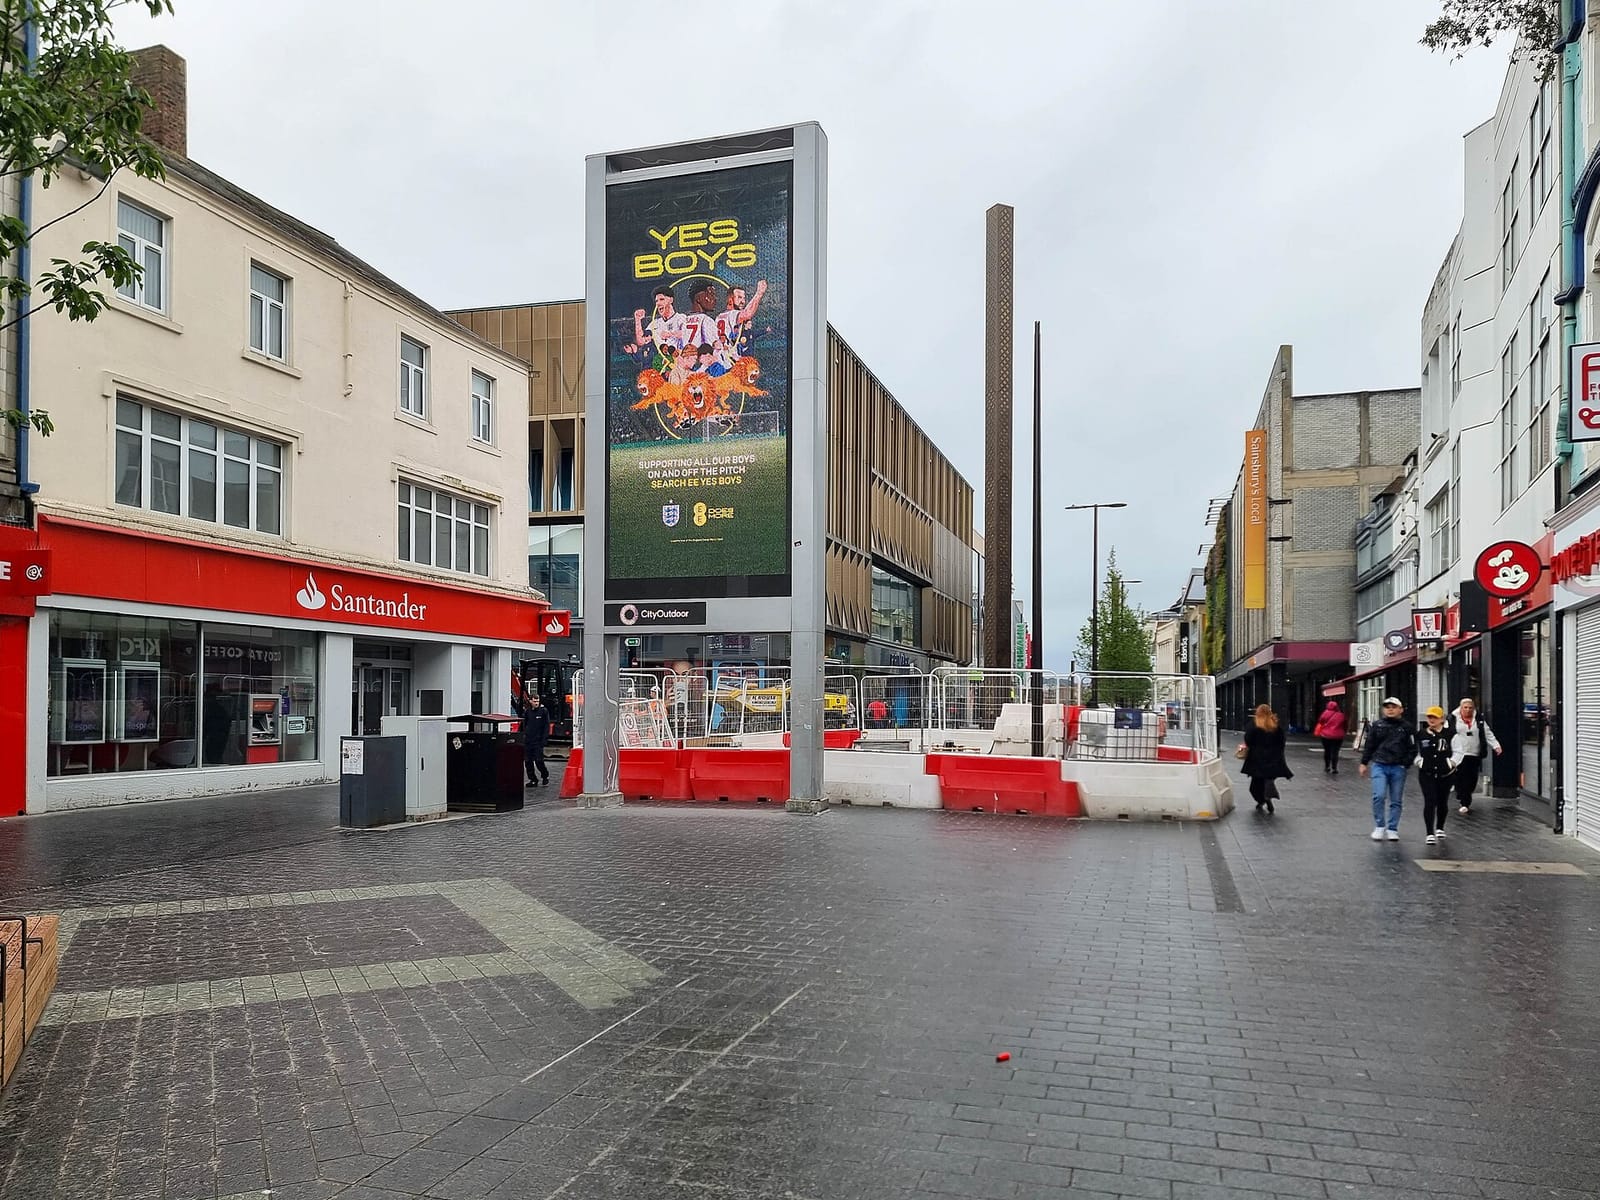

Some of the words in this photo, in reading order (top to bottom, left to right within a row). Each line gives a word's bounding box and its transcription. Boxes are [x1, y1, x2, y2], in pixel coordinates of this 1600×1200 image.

[649, 219, 739, 250] YES
[634, 243, 757, 278] BOYS
[686, 324, 698, 343] 7
[639, 459, 693, 469] SUPPORTING
[694, 457, 711, 466] ALL
[712, 456, 731, 465] OUR
[732, 454, 756, 464] BOYS
[1250, 436, 1262, 495] Sainsbury's
[648, 471, 660, 479] ON
[661, 470, 680, 478] AND
[681, 468, 699, 477] OFF
[701, 467, 718, 476] THE
[719, 466, 746, 475] PITCH
[650, 480, 687, 489] SEARCH
[687, 479, 700, 487] EE
[700, 477, 717, 486] YES
[719, 476, 742, 485] BOYS
[1250, 498, 1262, 525] Local
[331, 584, 427, 620] Santander
[640, 609, 690, 620] CityOutdoor
[1356, 645, 1371, 661] 3
